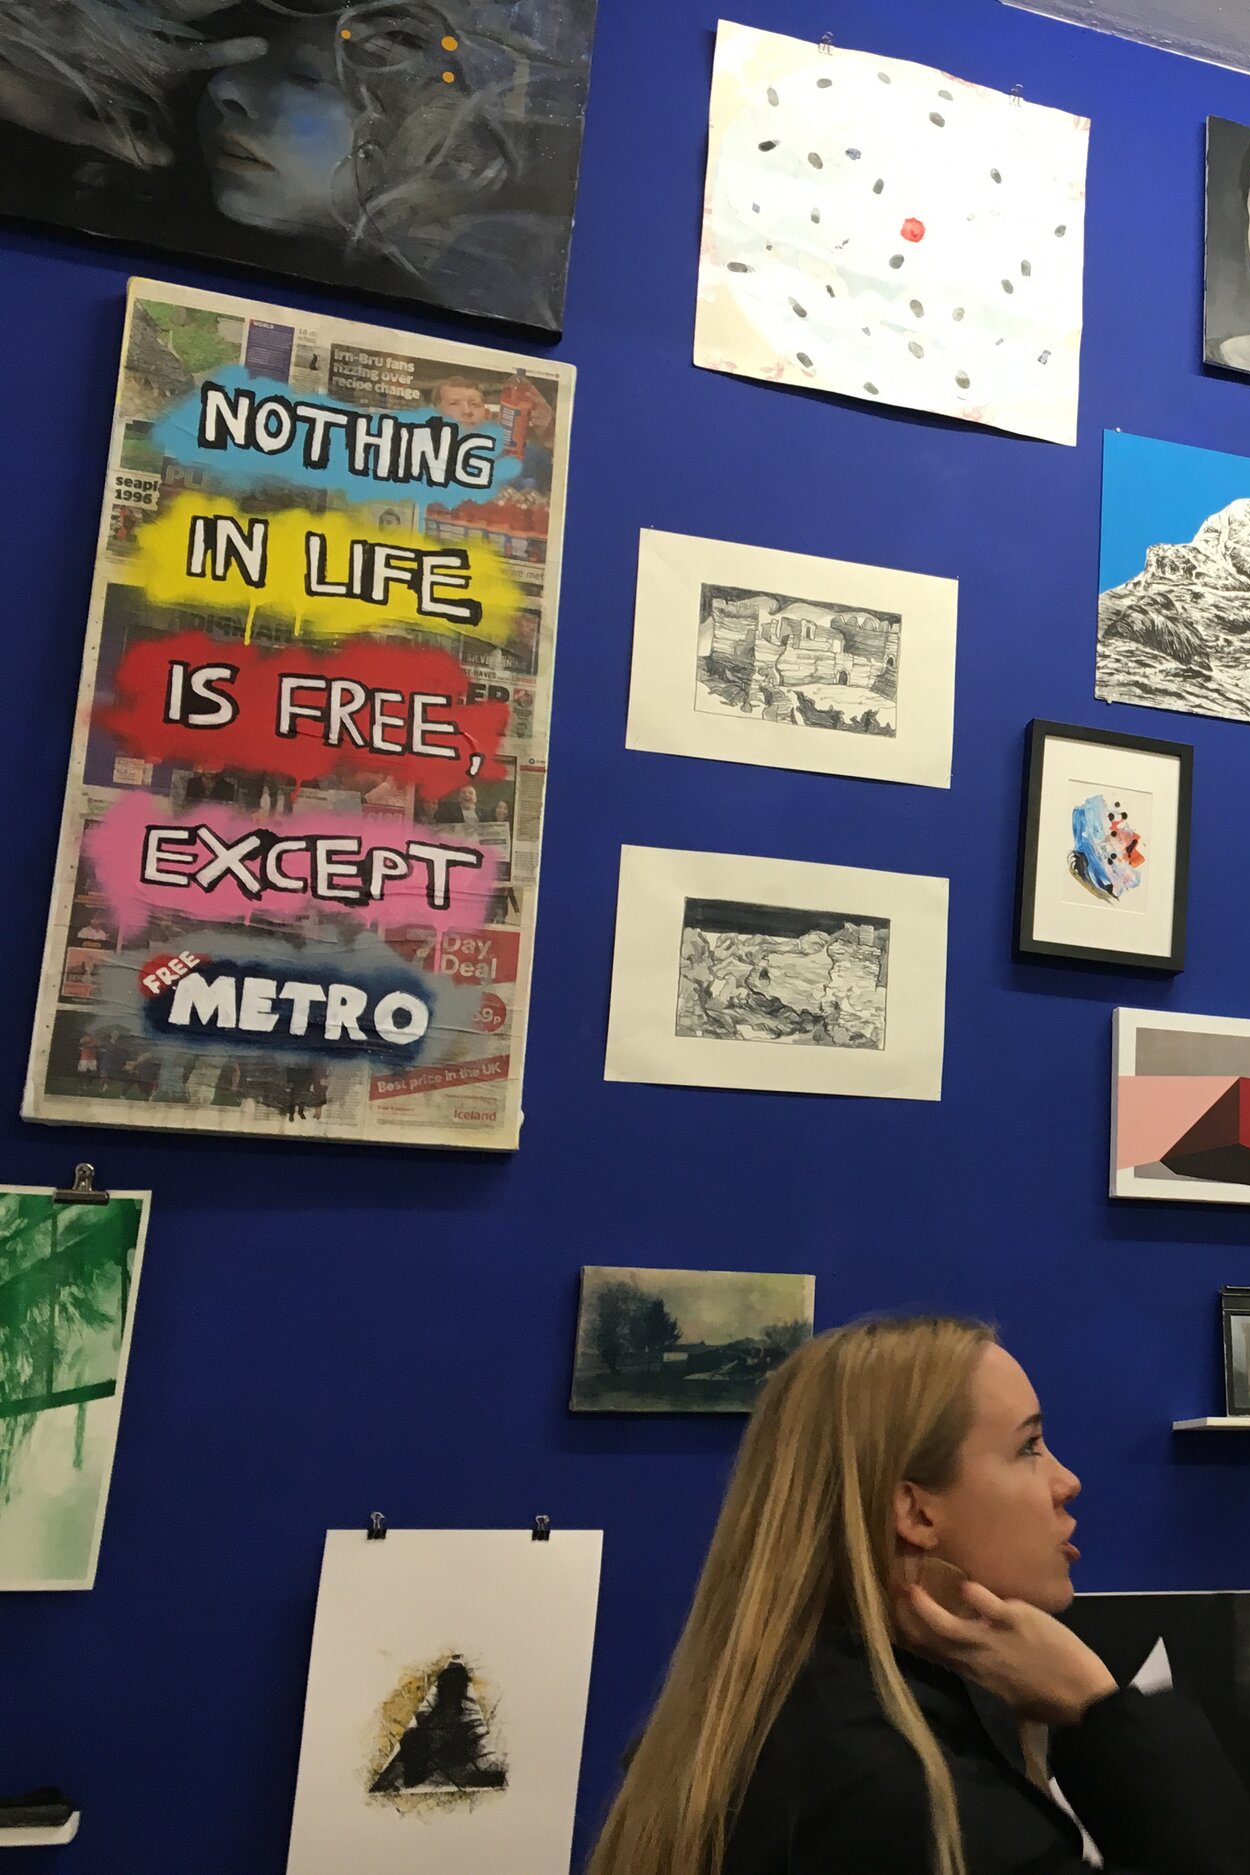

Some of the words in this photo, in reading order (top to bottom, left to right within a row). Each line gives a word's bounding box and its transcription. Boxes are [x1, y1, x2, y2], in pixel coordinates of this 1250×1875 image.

[334, 349, 384, 367] Irn-Bru
[386, 357, 415, 373] fans
[332, 376, 373, 392] recipe
[375, 381, 420, 399] change
[382, 370, 413, 385] over
[200, 382, 498, 488] NOTHING
[115, 476, 160, 492] seapl
[114, 489, 152, 505] 1996
[187, 515, 268, 588] IN
[305, 531, 482, 626] LIFE
[526, 570, 545, 581] met
[163, 660, 240, 730] IS
[275, 672, 484, 778] FREE,
[141, 824, 483, 909] EXCEPT
[142, 950, 201, 995] FREE
[441, 955, 497, 979] Deal
[168, 972, 430, 1045] METRO
[376, 1080, 407, 1094] Best
[408, 1073, 442, 1091] price
[458, 1066, 481, 1081] the
[481, 1061, 502, 1076] UK
[453, 1109, 497, 1122] Iceland
